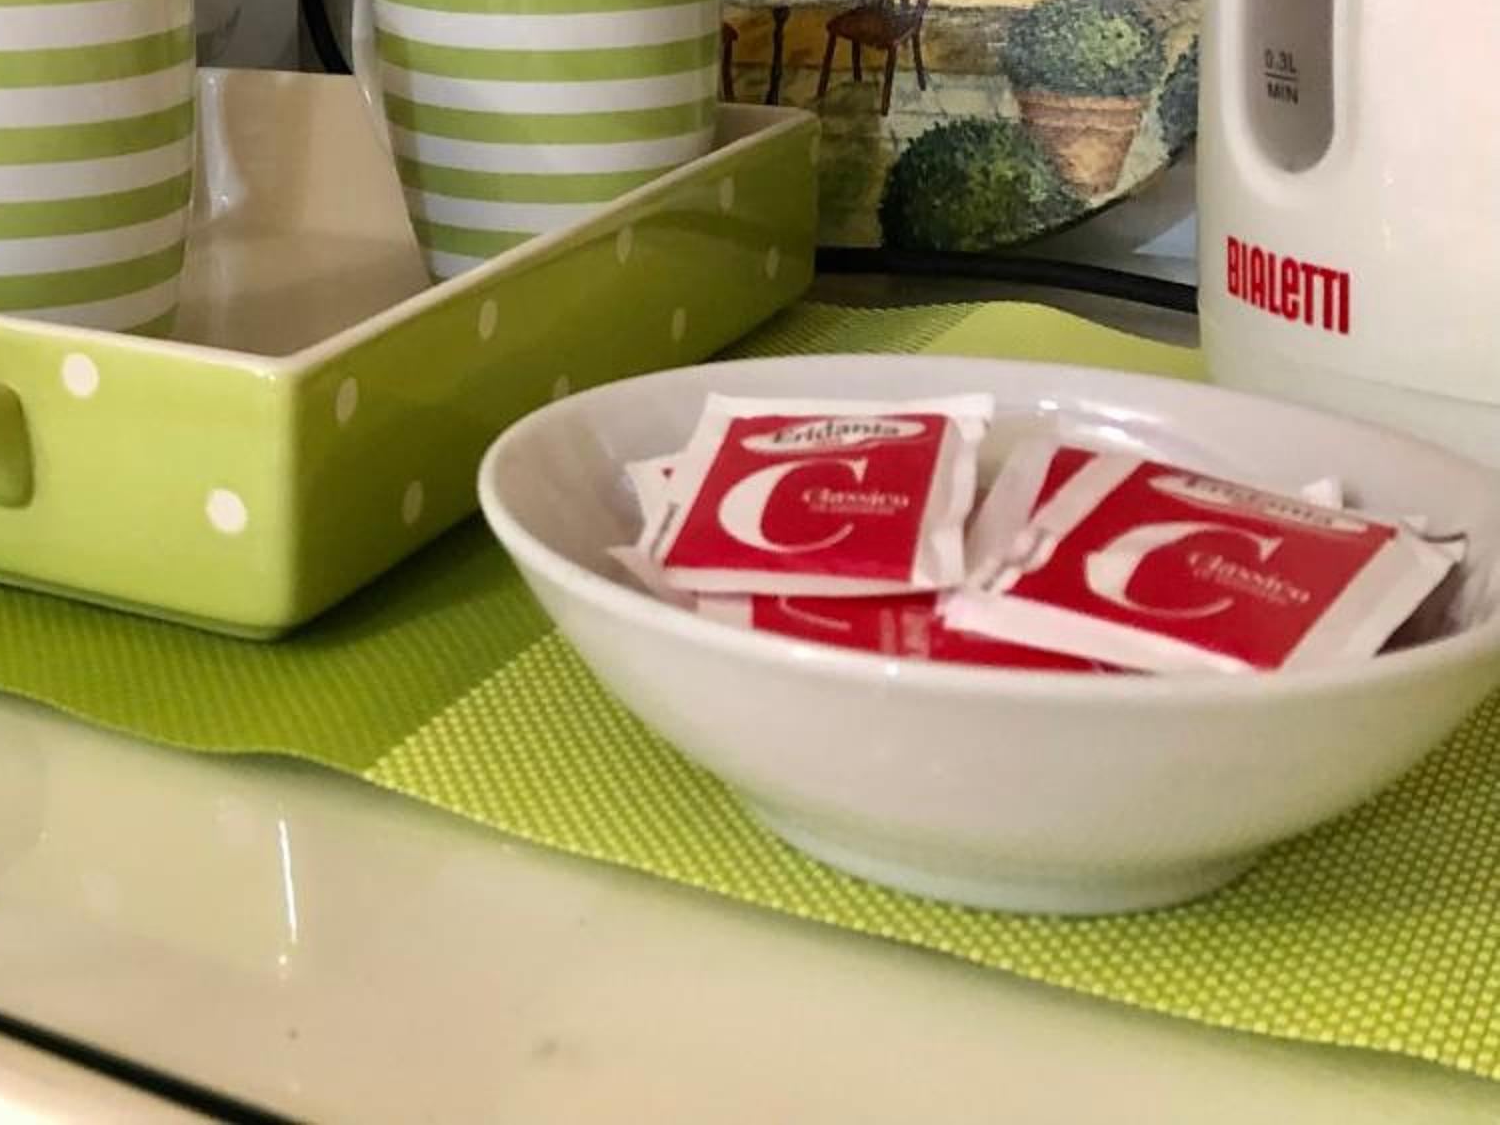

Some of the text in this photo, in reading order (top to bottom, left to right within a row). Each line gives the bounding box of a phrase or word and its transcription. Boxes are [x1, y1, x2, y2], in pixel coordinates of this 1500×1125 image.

[1264, 48, 1297, 74] 0.3L
[1267, 83, 1299, 105] MIN
[717, 457, 869, 554] C
[1083, 520, 1284, 620] C
